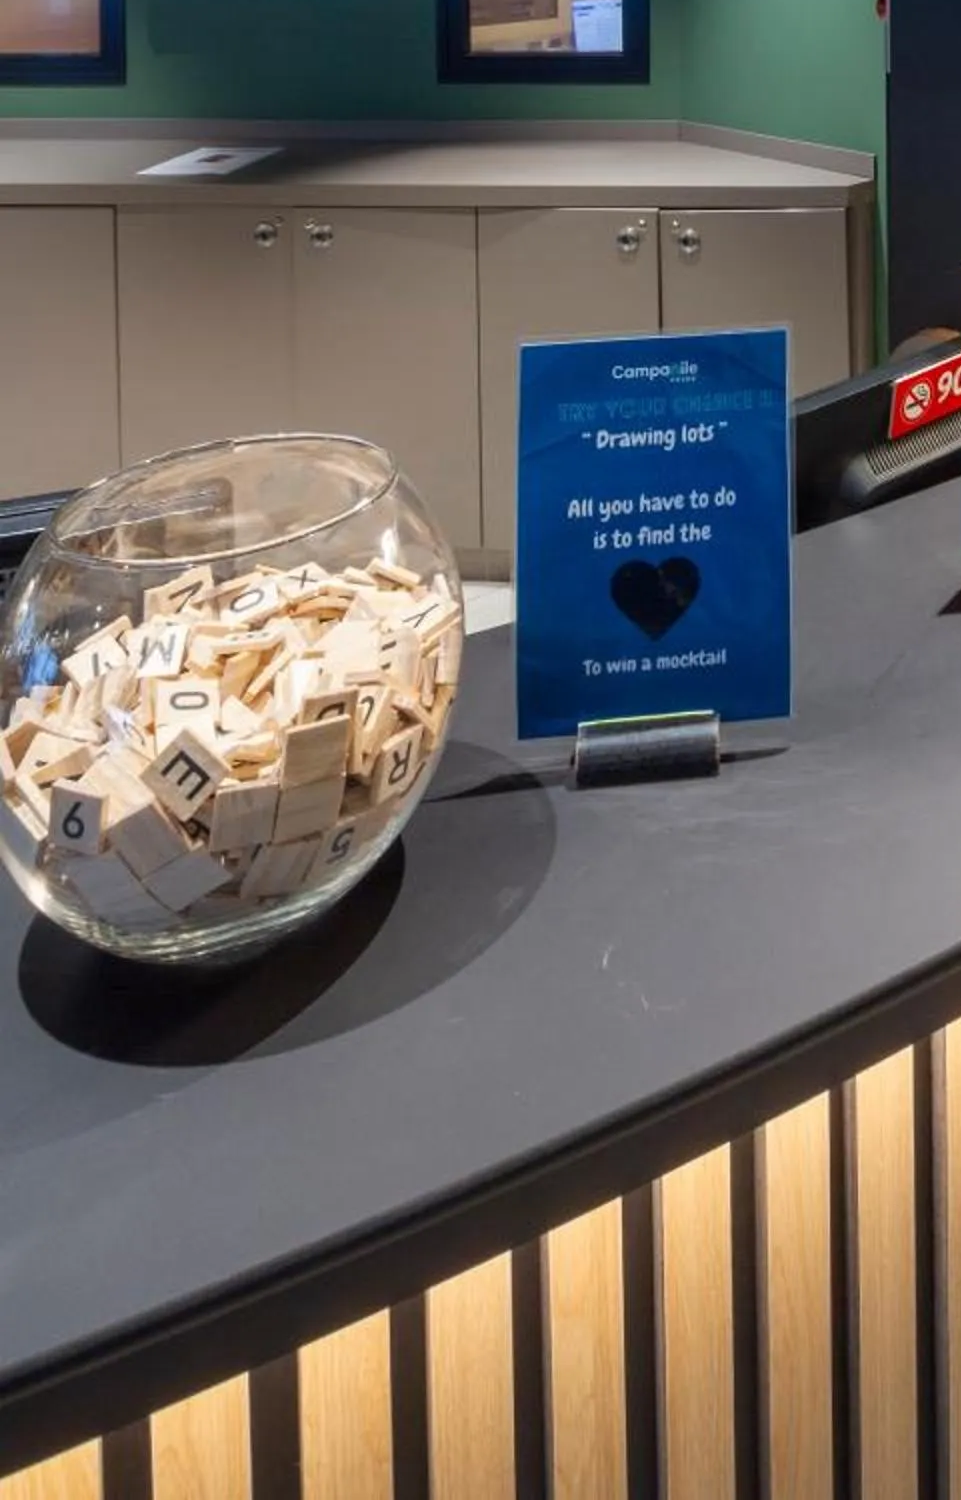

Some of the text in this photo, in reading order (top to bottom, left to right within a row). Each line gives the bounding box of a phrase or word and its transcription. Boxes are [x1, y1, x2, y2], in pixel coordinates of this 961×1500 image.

[611, 360, 699, 381] Campaile
[567, 485, 738, 523] All you have to do
[593, 522, 713, 550] is to find the
[582, 647, 728, 677] To win a mocktail
[160, 749, 212, 802] E
